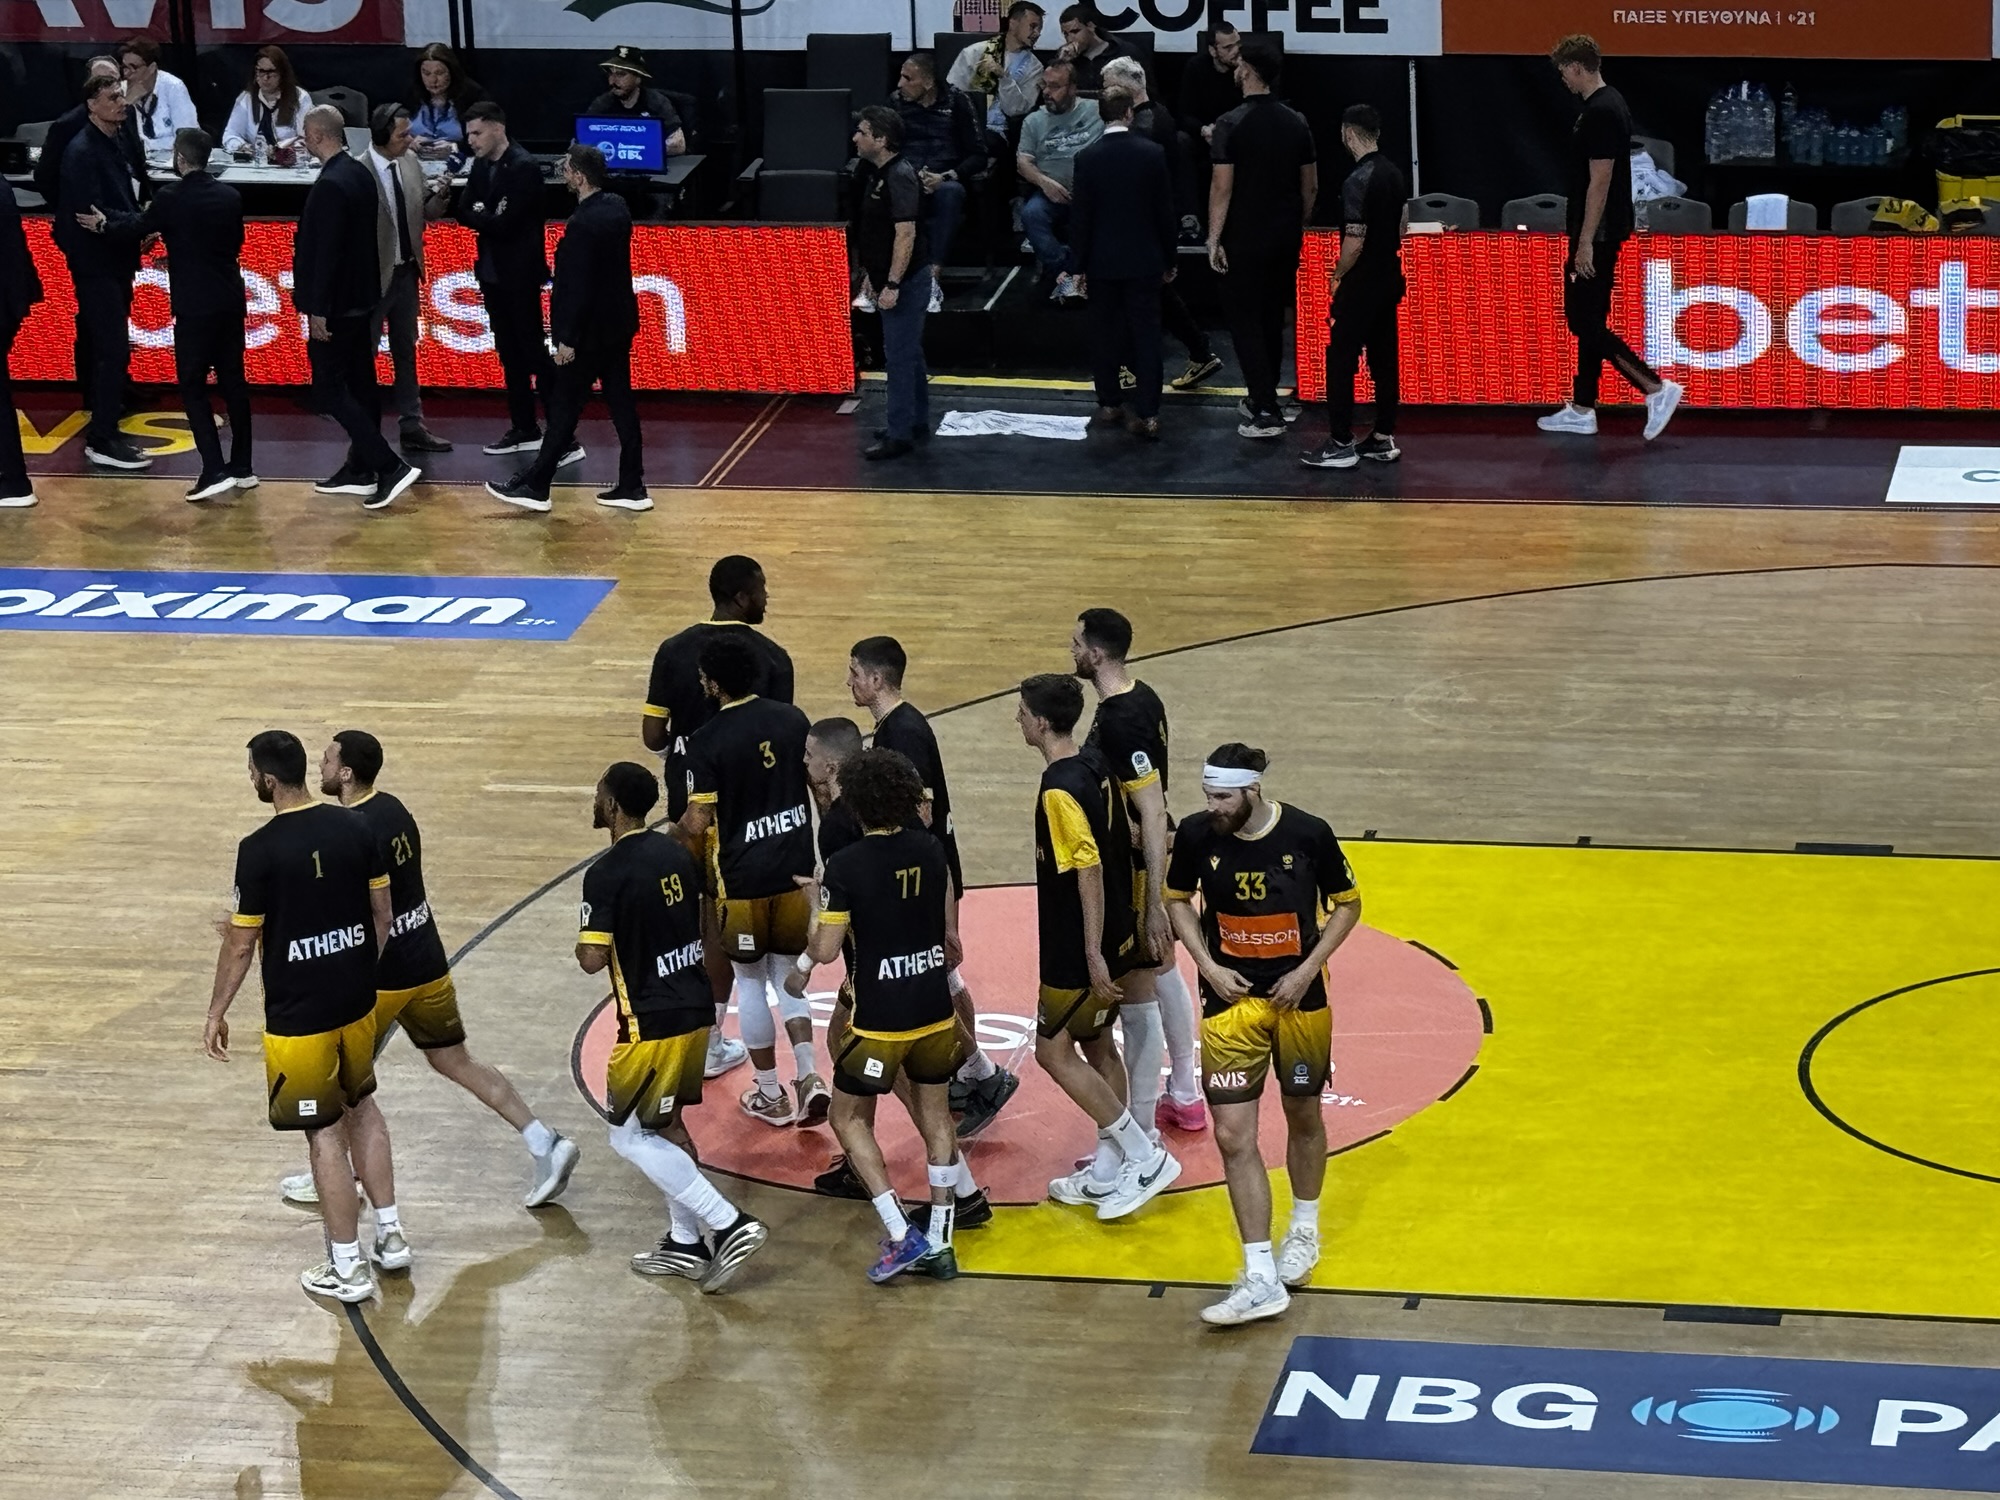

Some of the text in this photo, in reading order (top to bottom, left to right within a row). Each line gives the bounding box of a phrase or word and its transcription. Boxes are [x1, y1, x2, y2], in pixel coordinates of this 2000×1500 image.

[1613, 10, 1667, 24] ΠΑΙΞΕ
[1672, 10, 1772, 25] ΥΠΕΥΘΥΝΑ
[759, 741, 777, 769] 3
[312, 850, 324, 879] 1
[391, 832, 413, 866] 21
[660, 873, 683, 907] 59
[895, 866, 921, 899] 77
[1234, 872, 1267, 900] 33
[288, 923, 365, 962] ATHENS
[1208, 1071, 1247, 1089] AVIS
[1273, 1371, 1599, 1431] NBG
